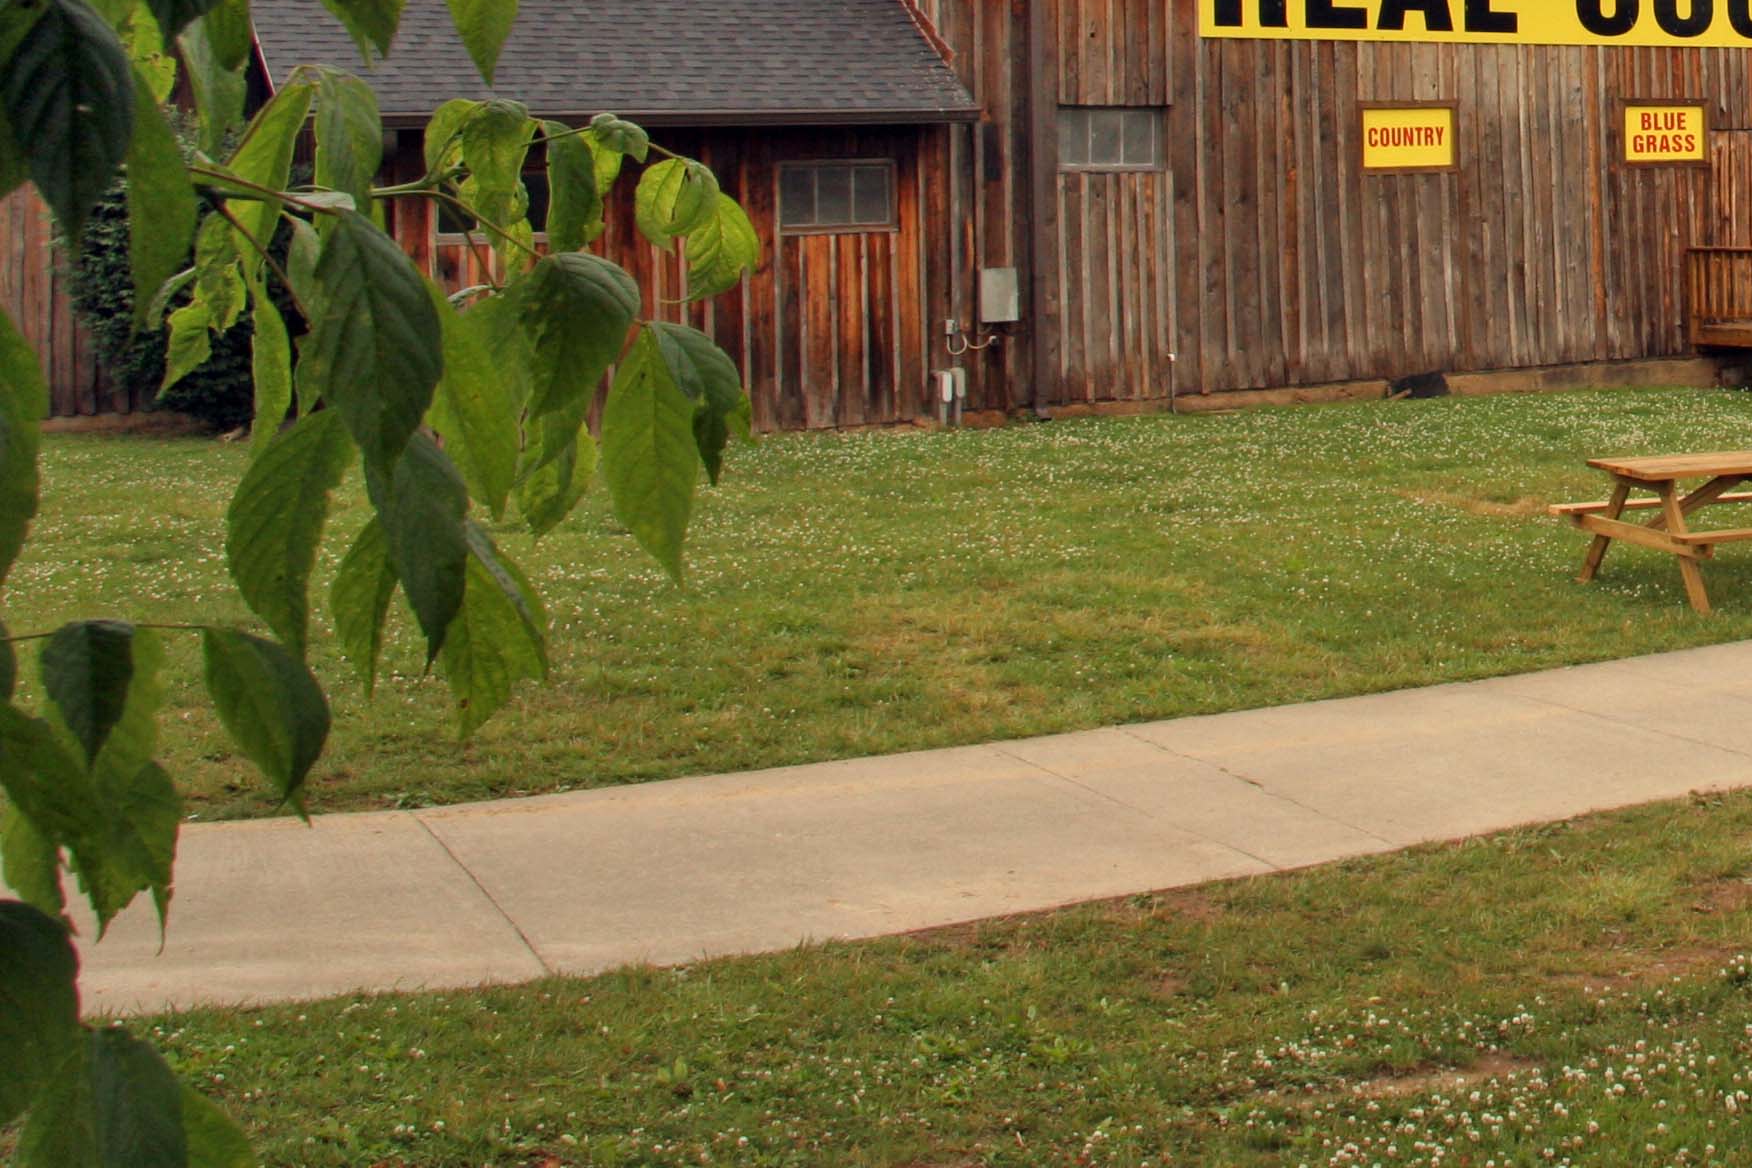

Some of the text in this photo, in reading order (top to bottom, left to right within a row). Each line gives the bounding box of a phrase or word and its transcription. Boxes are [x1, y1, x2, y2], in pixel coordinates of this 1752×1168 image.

[1641, 112, 1686, 131] BLUE
[1368, 127, 1444, 147] COUNTRY
[1633, 134, 1695, 153] GRASS
